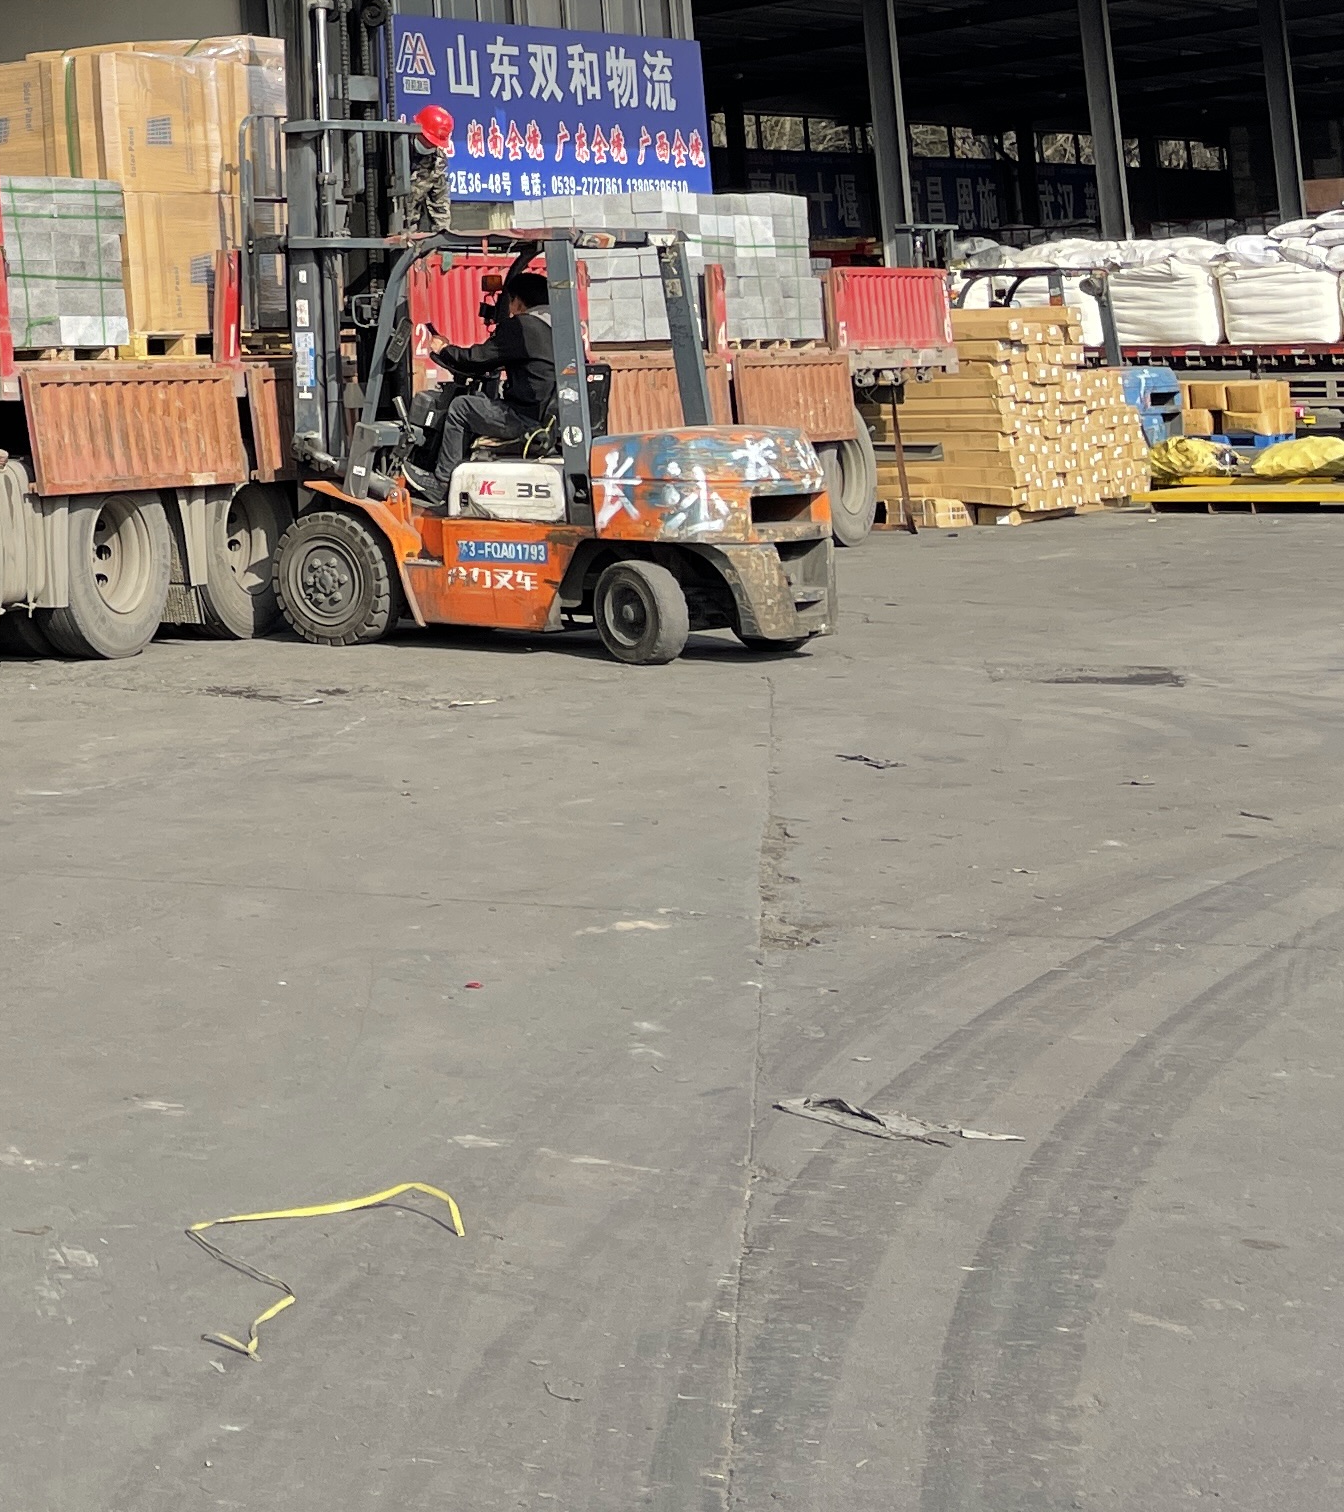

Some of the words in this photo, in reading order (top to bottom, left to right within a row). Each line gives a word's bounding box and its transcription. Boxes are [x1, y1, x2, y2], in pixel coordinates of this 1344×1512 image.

[445, 33, 678, 112] 山东双和物流
[467, 117, 545, 162] 湖南全境
[554, 120, 628, 165] 广东全境
[637, 125, 706, 168] 广西全境
[446, 170, 512, 196] 2区36-48号
[414, 322, 429, 357] 2
[717, 321, 727, 350] 4
